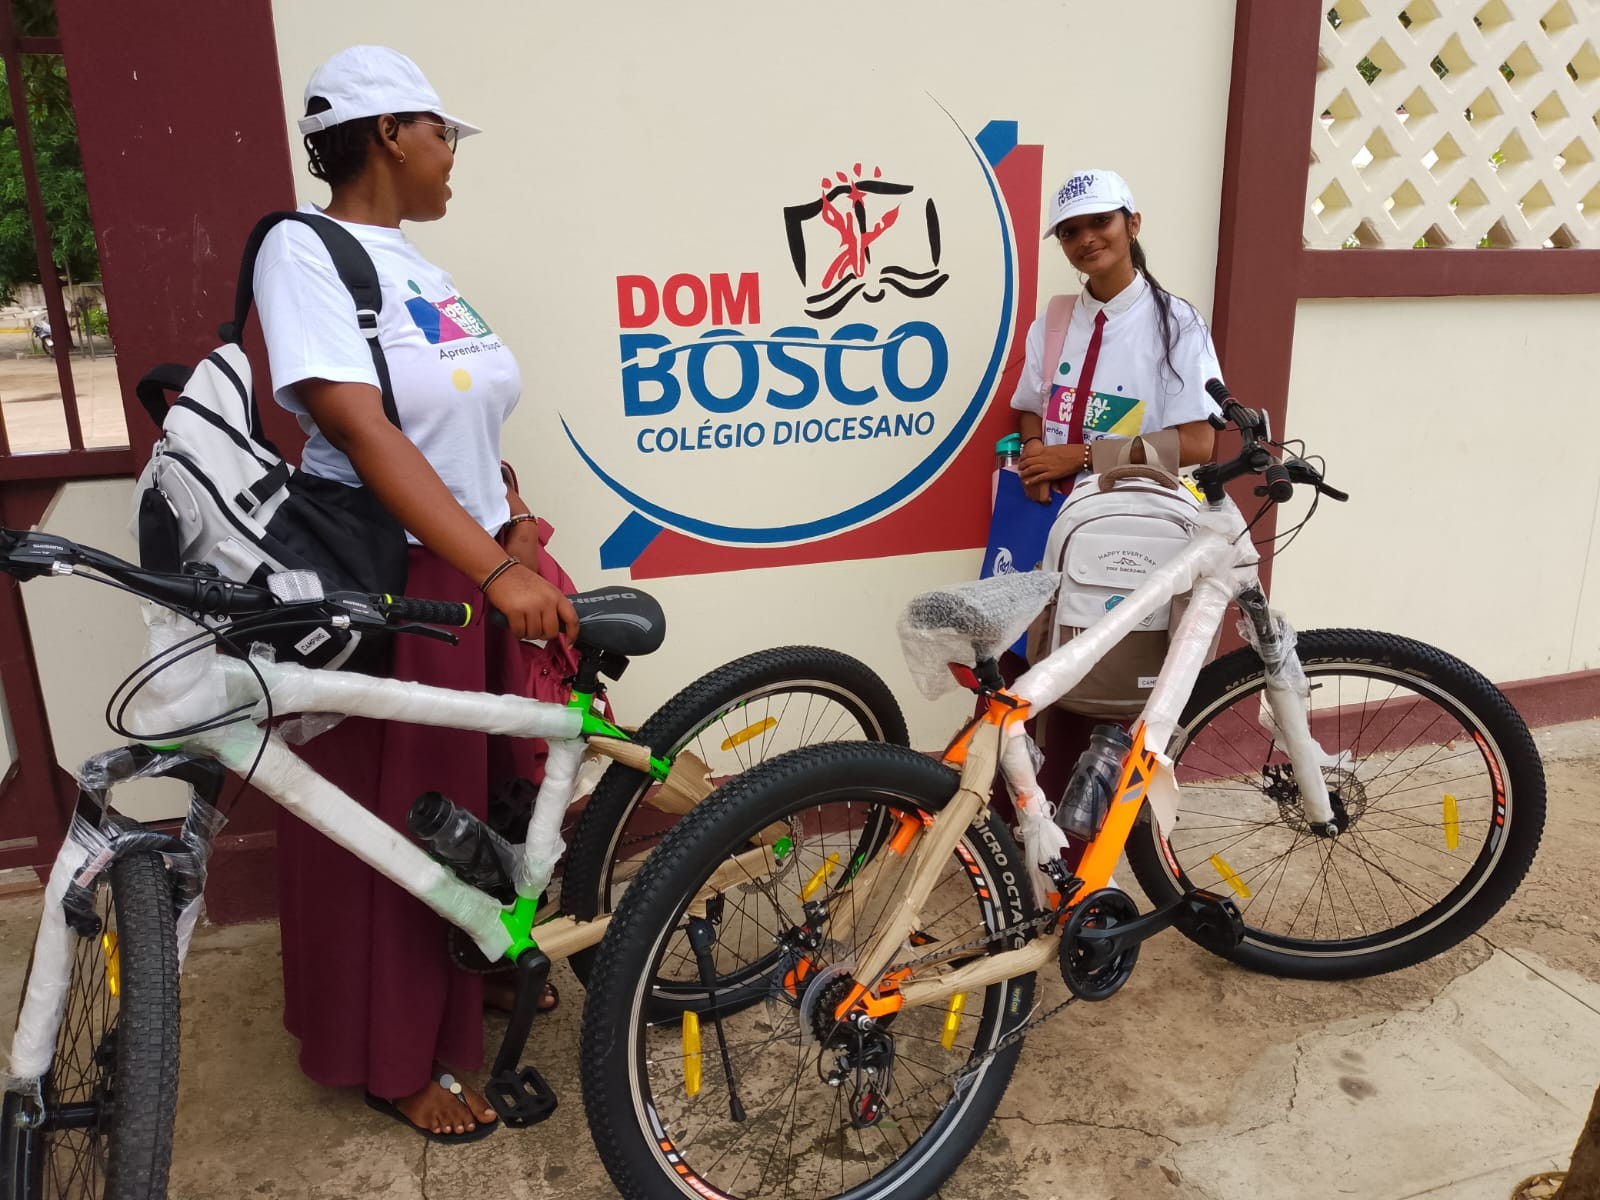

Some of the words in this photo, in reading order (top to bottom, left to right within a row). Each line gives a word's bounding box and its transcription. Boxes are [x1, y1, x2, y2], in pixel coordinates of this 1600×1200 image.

[616, 272, 761, 329] DOM
[619, 320, 949, 417] BOSCO
[637, 418, 766, 453] COLÉGIO
[773, 411, 935, 446] DIOCESANO
[1097, 550, 1121, 560] HAPPY
[1122, 550, 1143, 559] EVERY
[1144, 555, 1157, 566] DAY
[971, 815, 1009, 867] MICRO
[1002, 871, 1026, 949] OCTAVE
